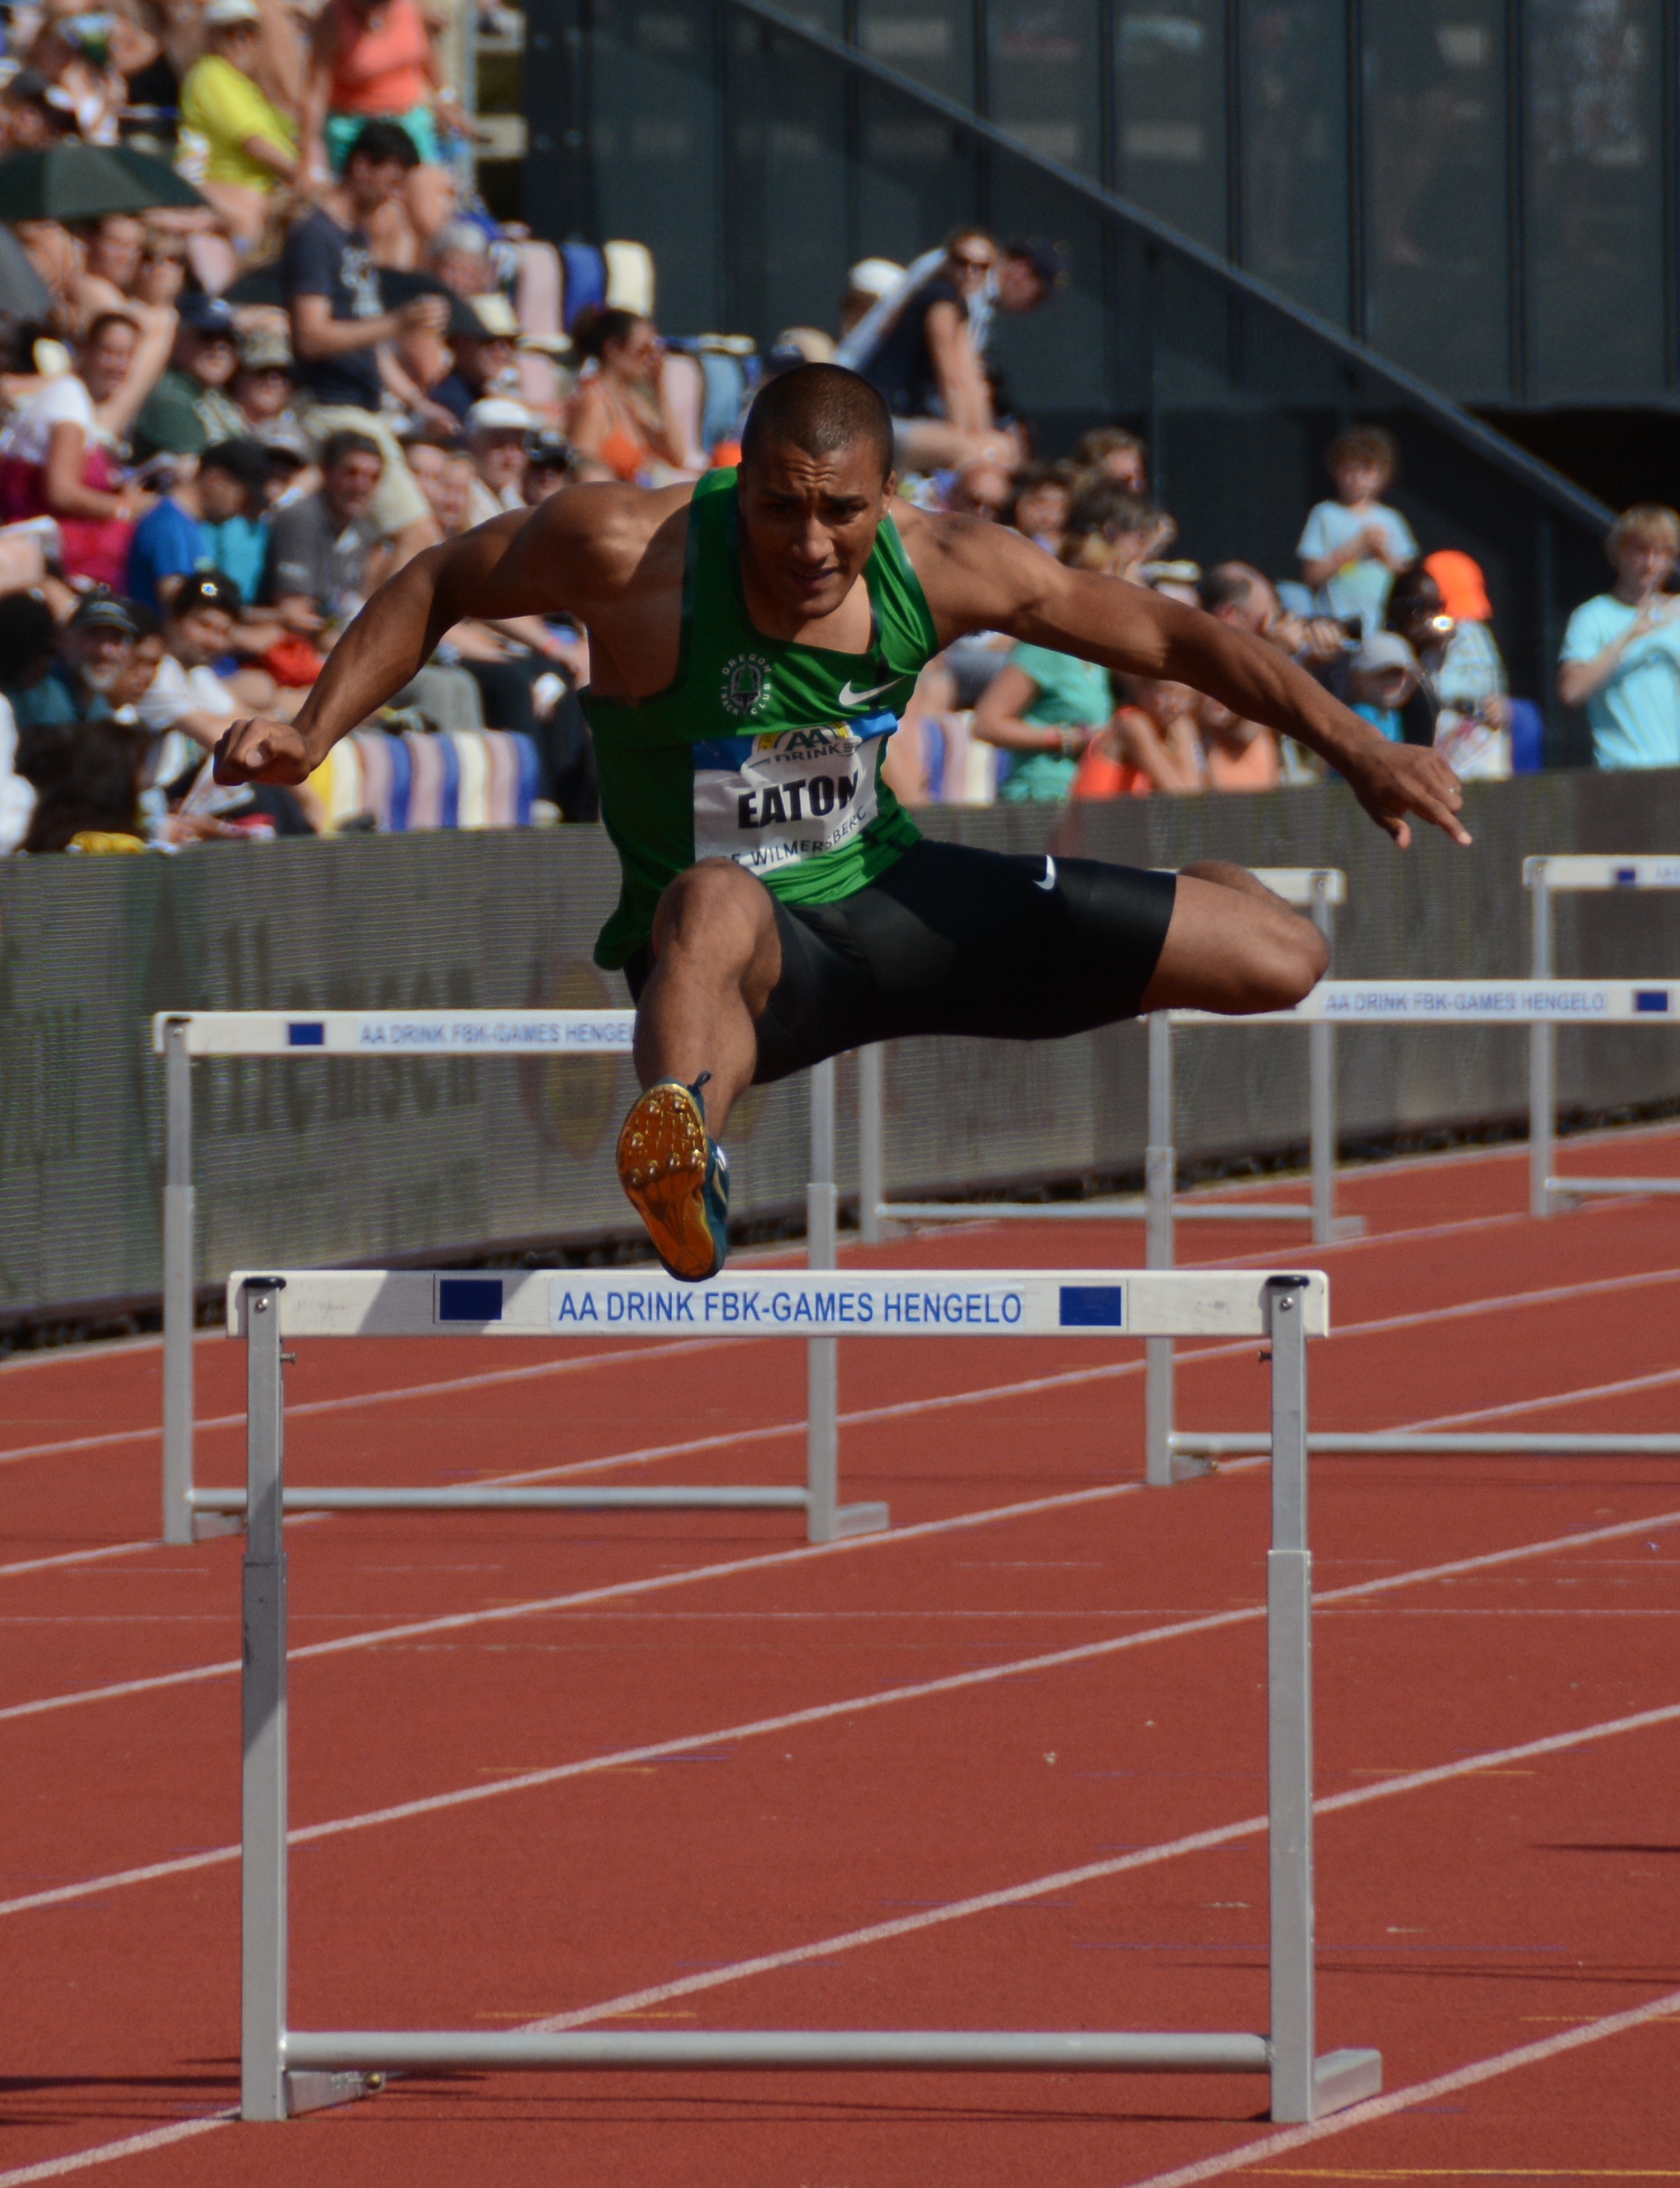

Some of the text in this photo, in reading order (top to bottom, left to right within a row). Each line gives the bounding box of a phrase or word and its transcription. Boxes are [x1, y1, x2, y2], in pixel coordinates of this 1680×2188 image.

[721, 654, 772, 675] OREGON
[720, 685, 739, 716] TRACK
[750, 682, 771, 715] CLUB
[775, 742, 842, 762] DRINK
[785, 728, 831, 752] AA
[737, 769, 859, 830] EATON
[1521, 993, 1605, 1013] HENGELO
[558, 1291, 1023, 1324] AA DRINK FBK-GAMES HENGELO
